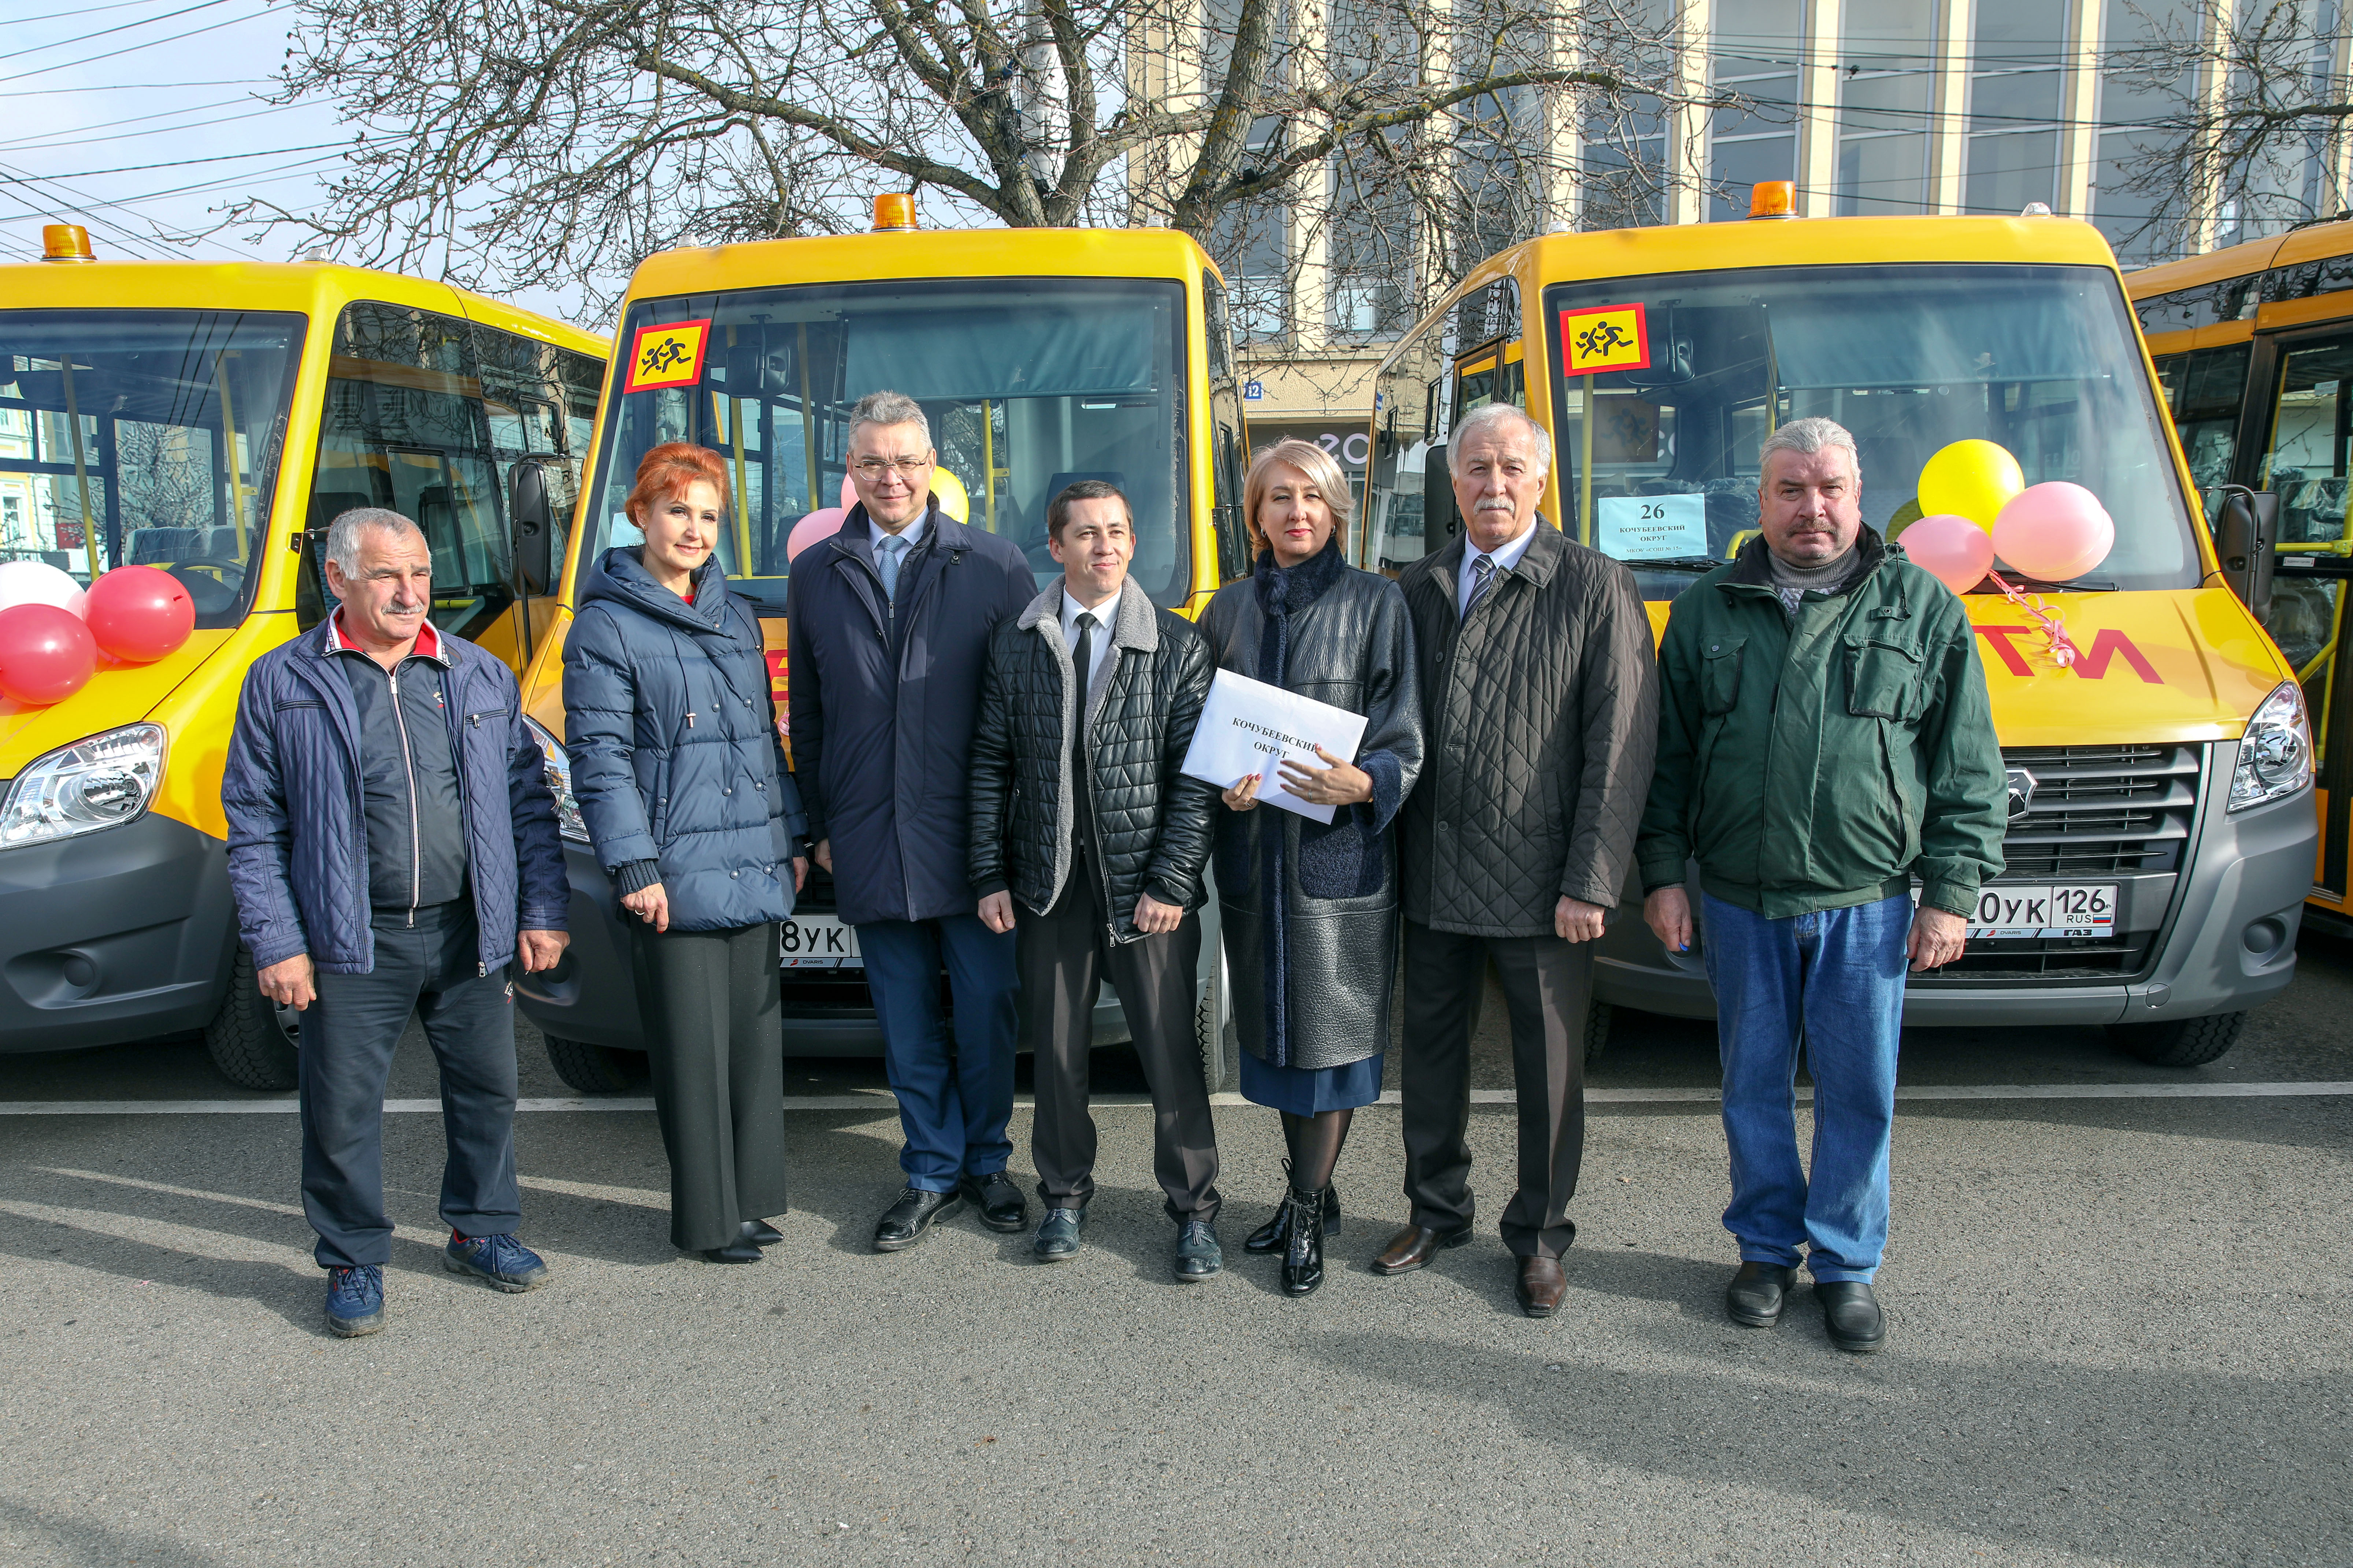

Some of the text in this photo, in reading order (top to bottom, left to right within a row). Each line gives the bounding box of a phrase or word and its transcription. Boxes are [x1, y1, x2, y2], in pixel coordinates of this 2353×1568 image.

[1248, 385, 1259, 397] 12
[1640, 503, 1665, 519] 26
[1619, 524, 1685, 533] КОЧУБЕЕВСКИЙ
[1254, 742, 1290, 759] ОКРУГ
[1967, 889, 2105, 924] 0УК 126
[2067, 914, 2091, 924] RUS
